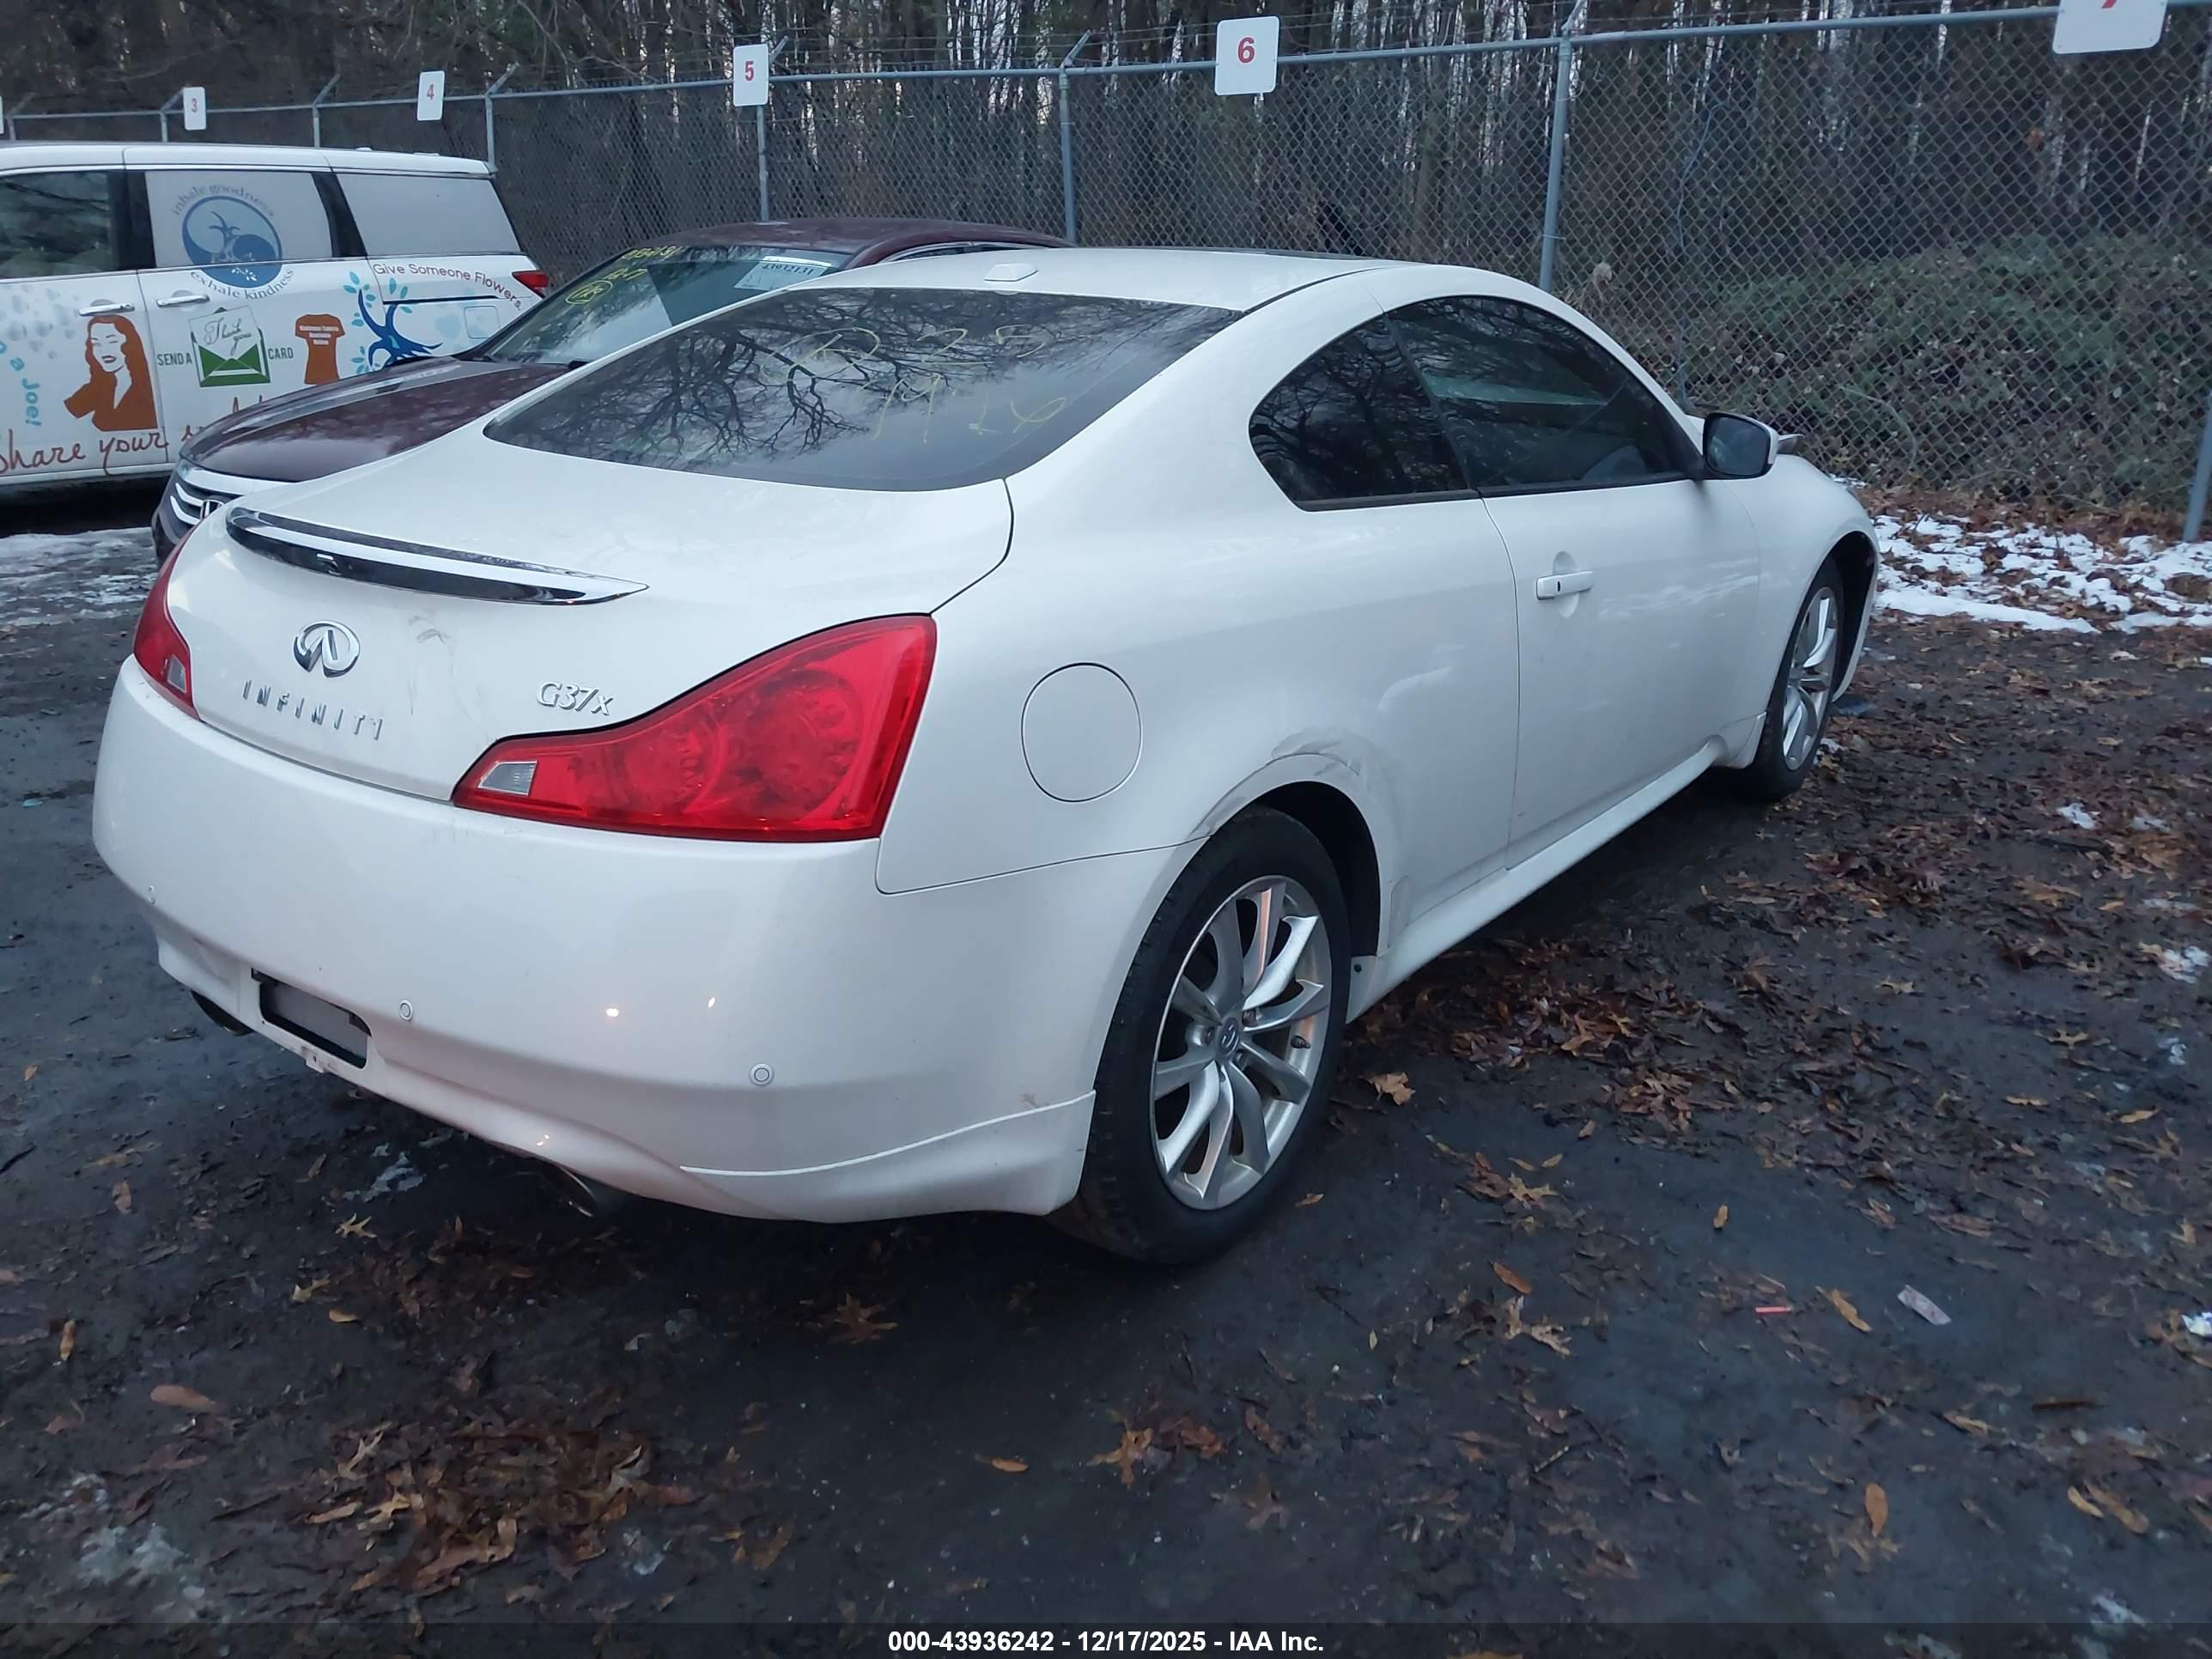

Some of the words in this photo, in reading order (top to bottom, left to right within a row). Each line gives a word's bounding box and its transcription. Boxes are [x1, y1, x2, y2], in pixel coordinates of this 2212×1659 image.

[1237, 37, 1255, 64] 6
[744, 60, 755, 82] 5
[191, 98, 198, 113] 3
[426, 84, 434, 100] 4
[173, 185, 207, 216] inhale
[209, 184, 274, 216] goodness
[191, 271, 240, 299] exhale
[244, 269, 294, 301] kindness
[373, 264, 405, 275] Give
[409, 263, 471, 282] Someone
[204, 316, 242, 345] Thank
[231, 332, 252, 356] you
[157, 353, 182, 367] SEND
[183, 356, 192, 365] A
[268, 347, 294, 361] CARD
[22, 378, 42, 427] Joe!
[100, 432, 169, 476] your
[242, 679, 383, 741] INFINITI
